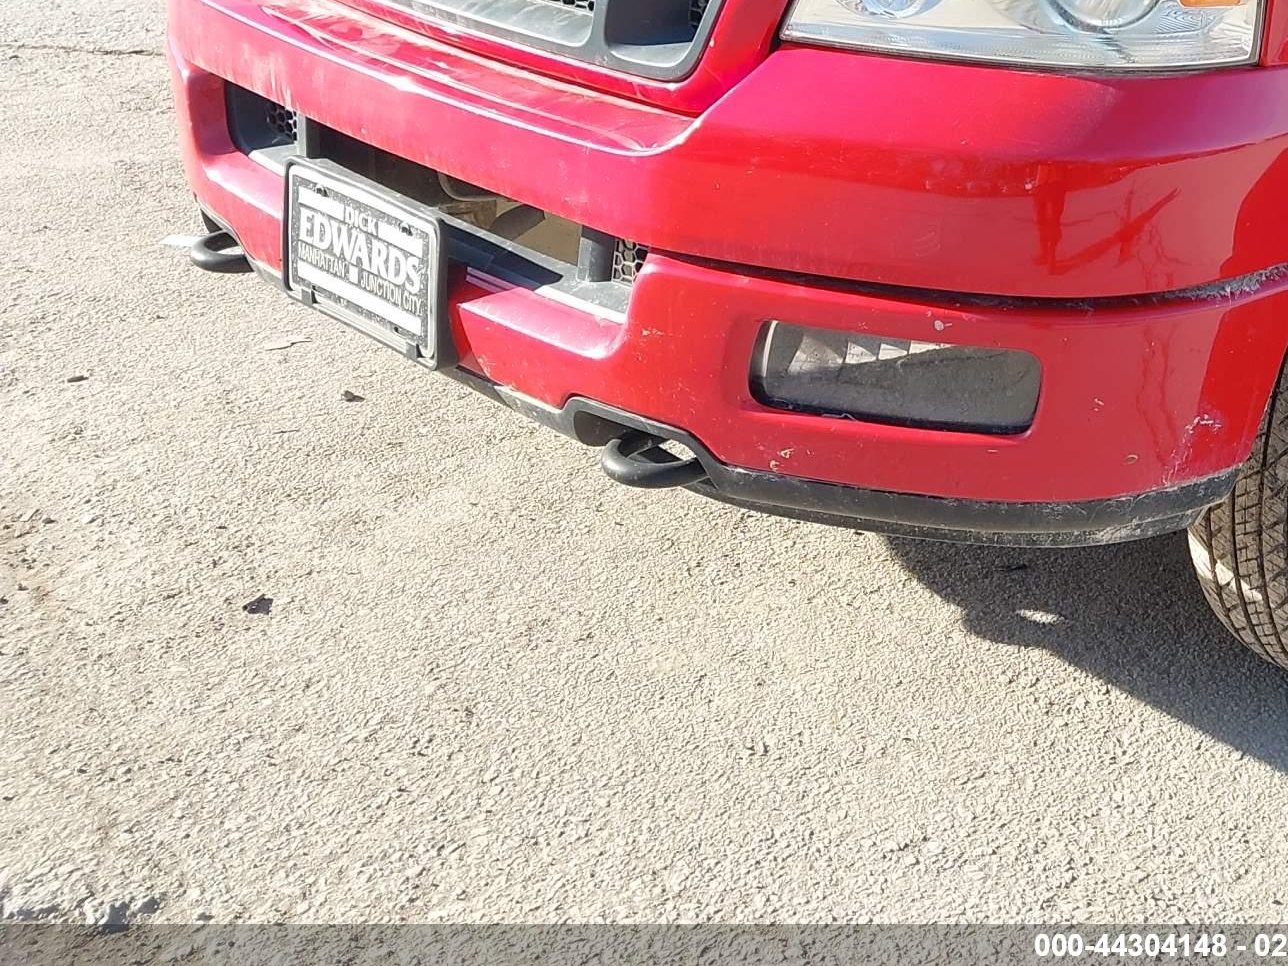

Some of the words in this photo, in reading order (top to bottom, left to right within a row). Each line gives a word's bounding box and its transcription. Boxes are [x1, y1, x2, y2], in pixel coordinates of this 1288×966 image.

[300, 208, 421, 293] EDWARDS
[344, 204, 377, 235] DICK
[299, 244, 345, 278] MANHATTAN
[360, 275, 402, 307] JUNCTION
[403, 292, 422, 315] CITY
